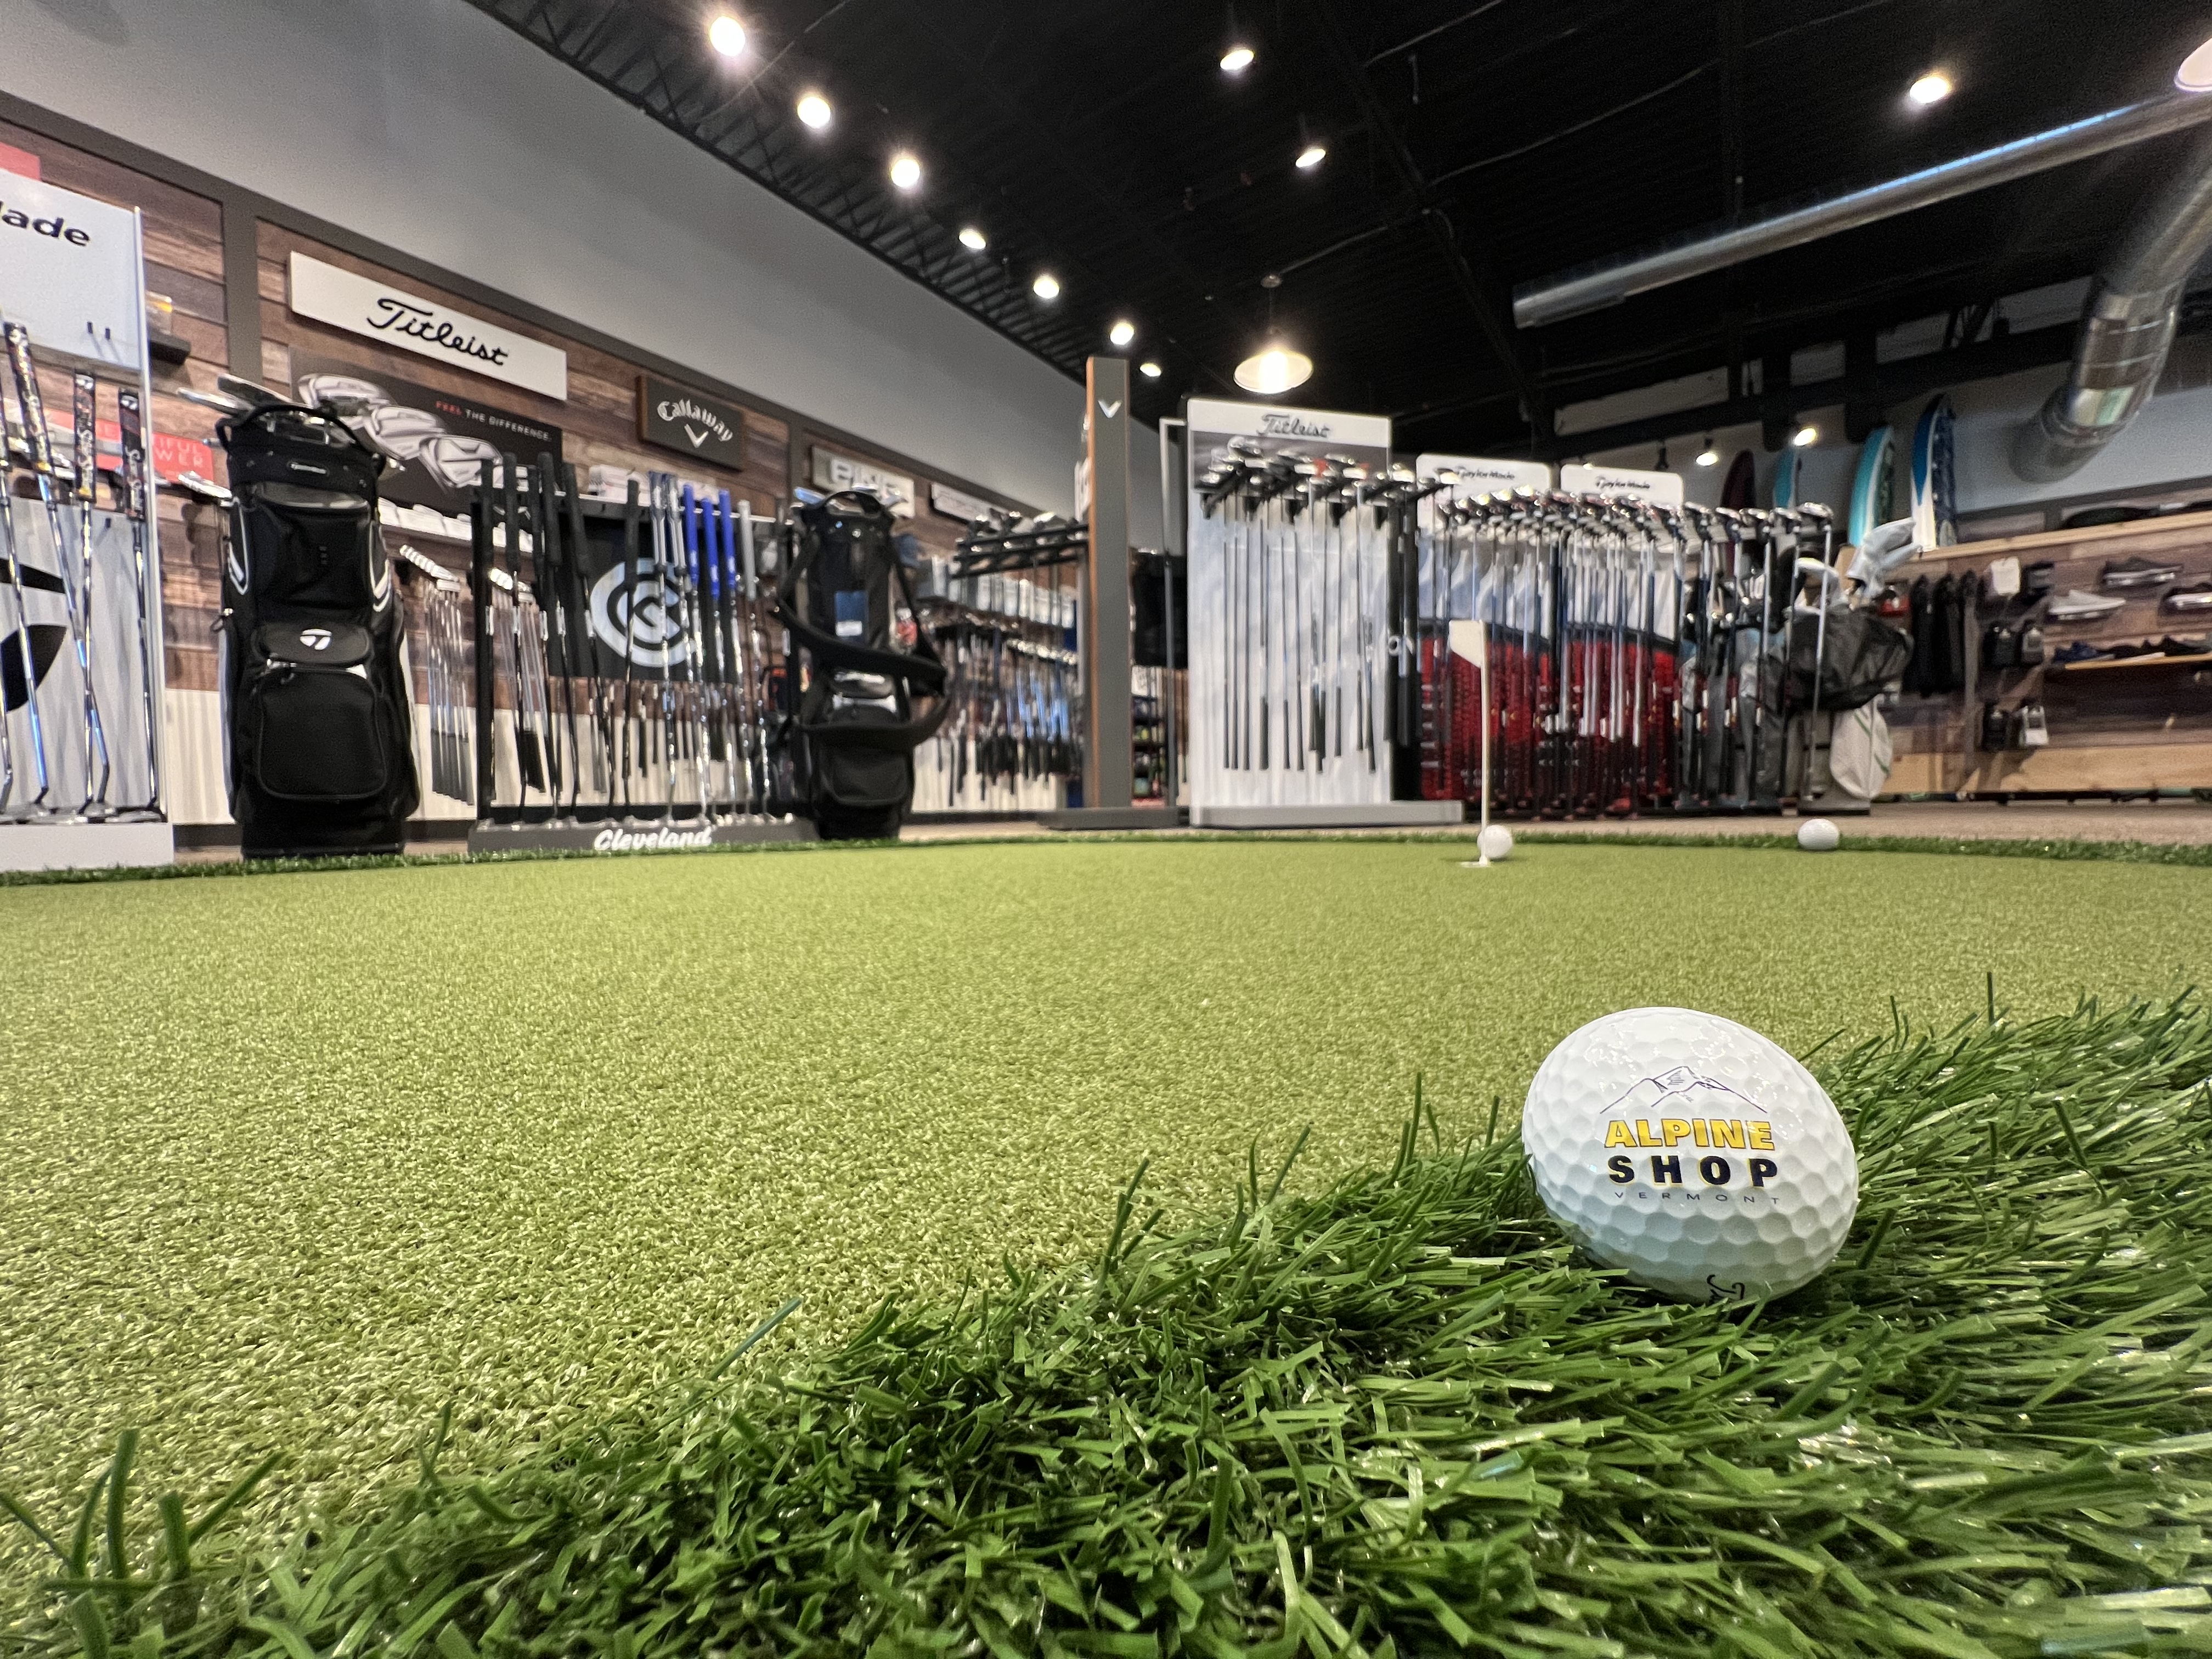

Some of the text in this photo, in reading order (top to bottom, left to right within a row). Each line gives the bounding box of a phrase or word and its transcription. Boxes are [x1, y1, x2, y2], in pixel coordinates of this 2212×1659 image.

[0, 200, 91, 246] ade
[366, 298, 508, 365] Titleist
[466, 409, 486, 423] THE
[657, 398, 733, 442] Callaway
[1256, 414, 1330, 438] Titleist
[594, 827, 713, 851] Cleveland
[1604, 1118, 1775, 1150] ALPINE
[1607, 1155, 1778, 1187] SHOP
[1615, 1191, 1779, 1205] VERMONT
